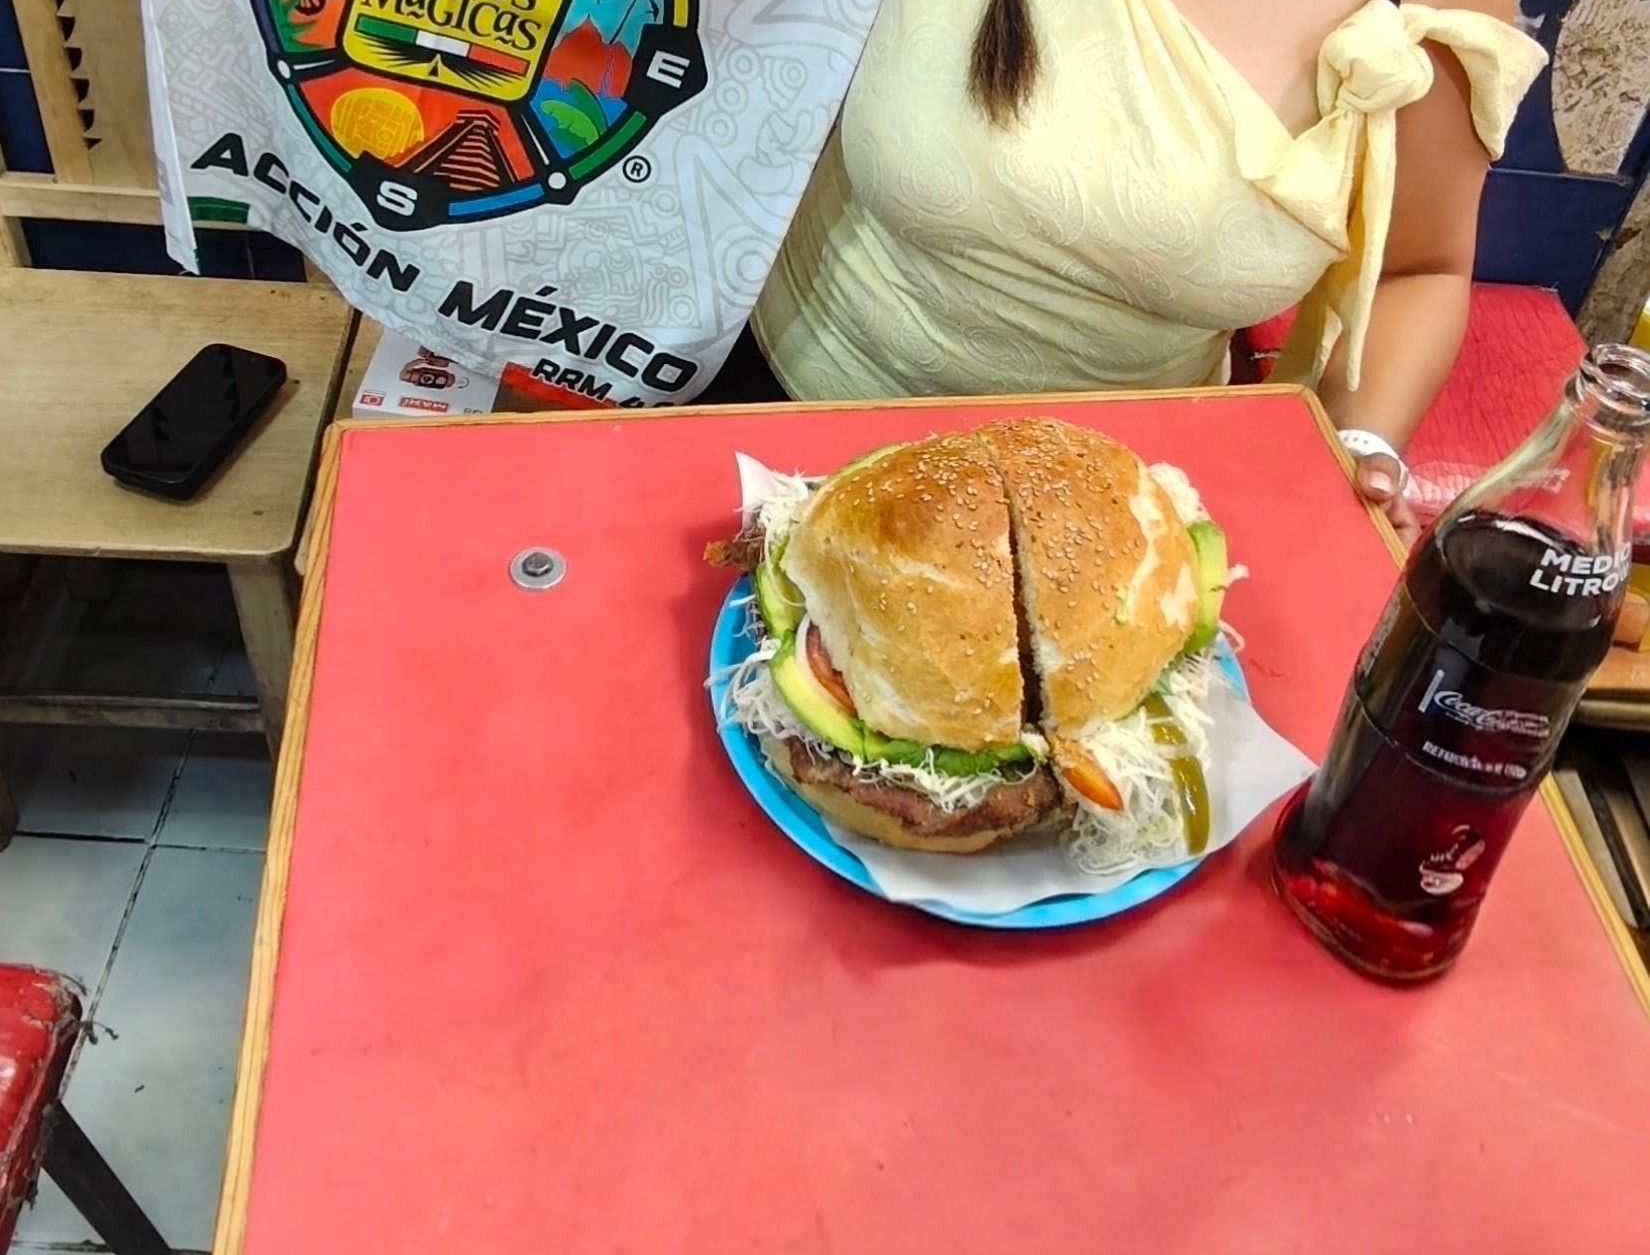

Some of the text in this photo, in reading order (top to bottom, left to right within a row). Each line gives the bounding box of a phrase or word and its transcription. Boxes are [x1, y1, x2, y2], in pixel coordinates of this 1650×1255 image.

[646, 50, 691, 89] E
[376, 180, 418, 217] S
[190, 133, 699, 394] ACCIÓN MÉXICO
[531, 358, 613, 401] RRM
[1540, 541, 1632, 575] MEDIO
[1530, 569, 1620, 596] LITRO
